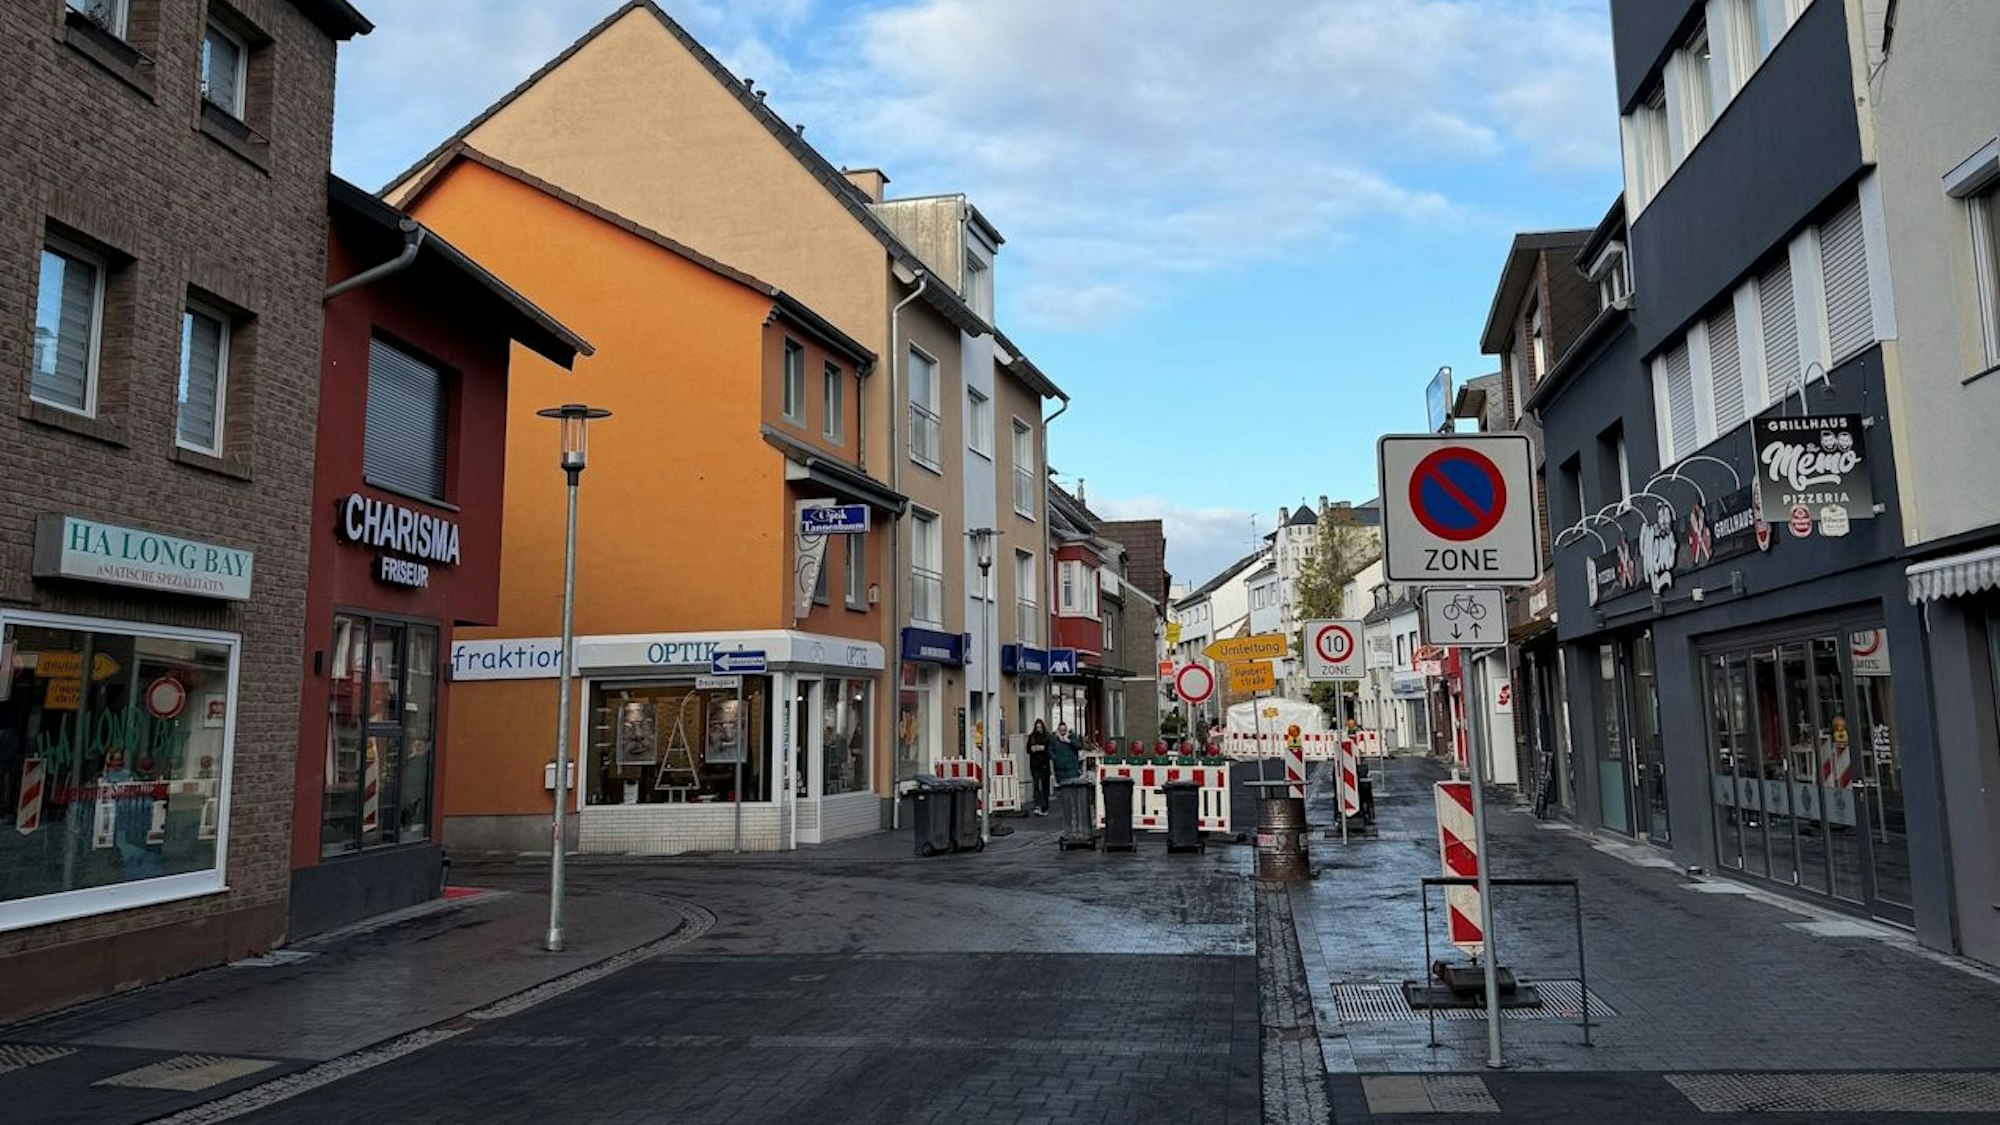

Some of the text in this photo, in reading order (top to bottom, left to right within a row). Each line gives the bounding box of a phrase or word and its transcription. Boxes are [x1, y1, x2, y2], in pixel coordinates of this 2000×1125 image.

[1768, 417, 1848, 431] GRILLHAUS
[1761, 440, 1862, 491] Memo
[1782, 492, 1850, 505] PIZZERIA
[346, 493, 461, 566] CHARISMA
[1714, 507, 1755, 539] GRILLHAUS
[69, 522, 249, 577] HA LONG BAY
[1424, 549, 1500, 571] ZONE
[97, 564, 155, 583] ASIATISCHE
[381, 556, 429, 589] FRISEUR
[647, 642, 720, 663] OPTIK
[1220, 643, 1280, 656] Umleitung
[1325, 635, 1344, 653] 10
[1049, 661, 1071, 673] AXA
[1321, 665, 1350, 676] ZONE
